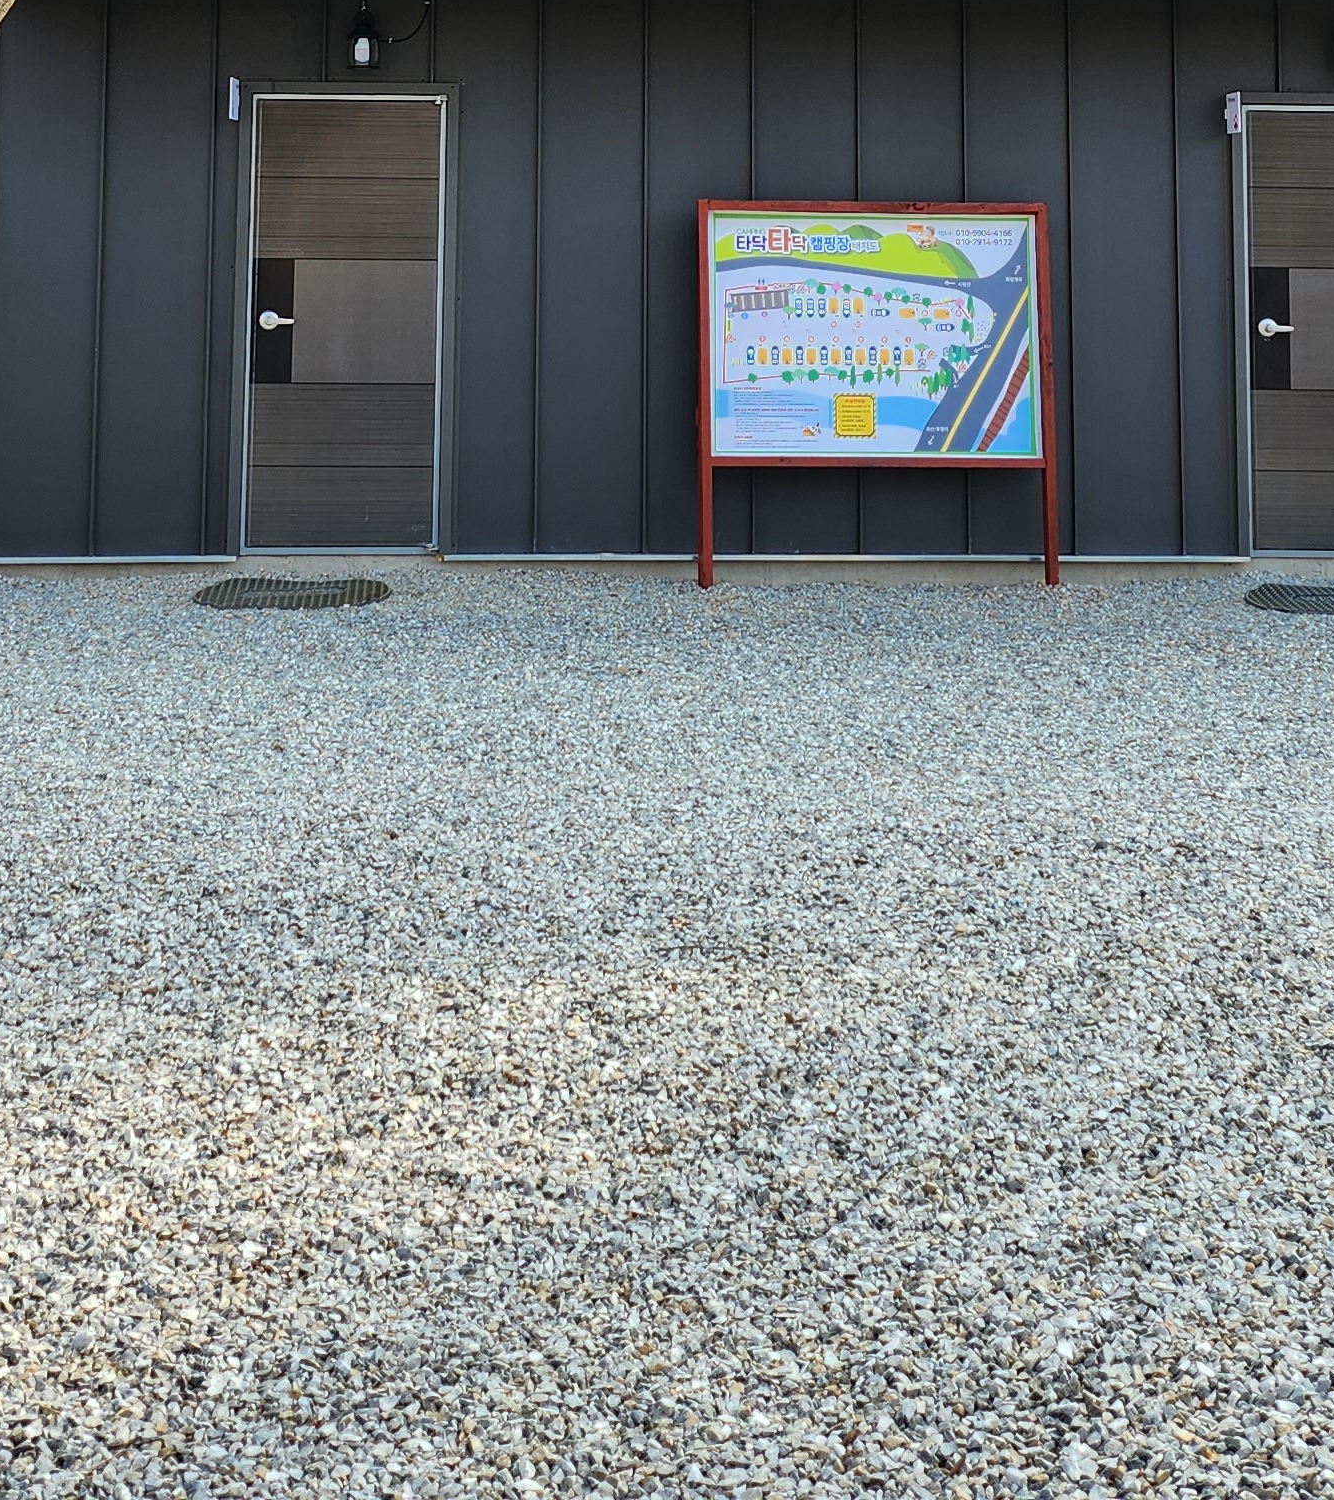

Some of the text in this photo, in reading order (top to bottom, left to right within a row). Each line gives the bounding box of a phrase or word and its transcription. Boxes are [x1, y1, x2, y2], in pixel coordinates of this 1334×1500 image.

[810, 235, 851, 252] 캠핑장
[852, 240, 880, 252] 배치도
[955, 238, 1013, 246] 010-7914-9172
